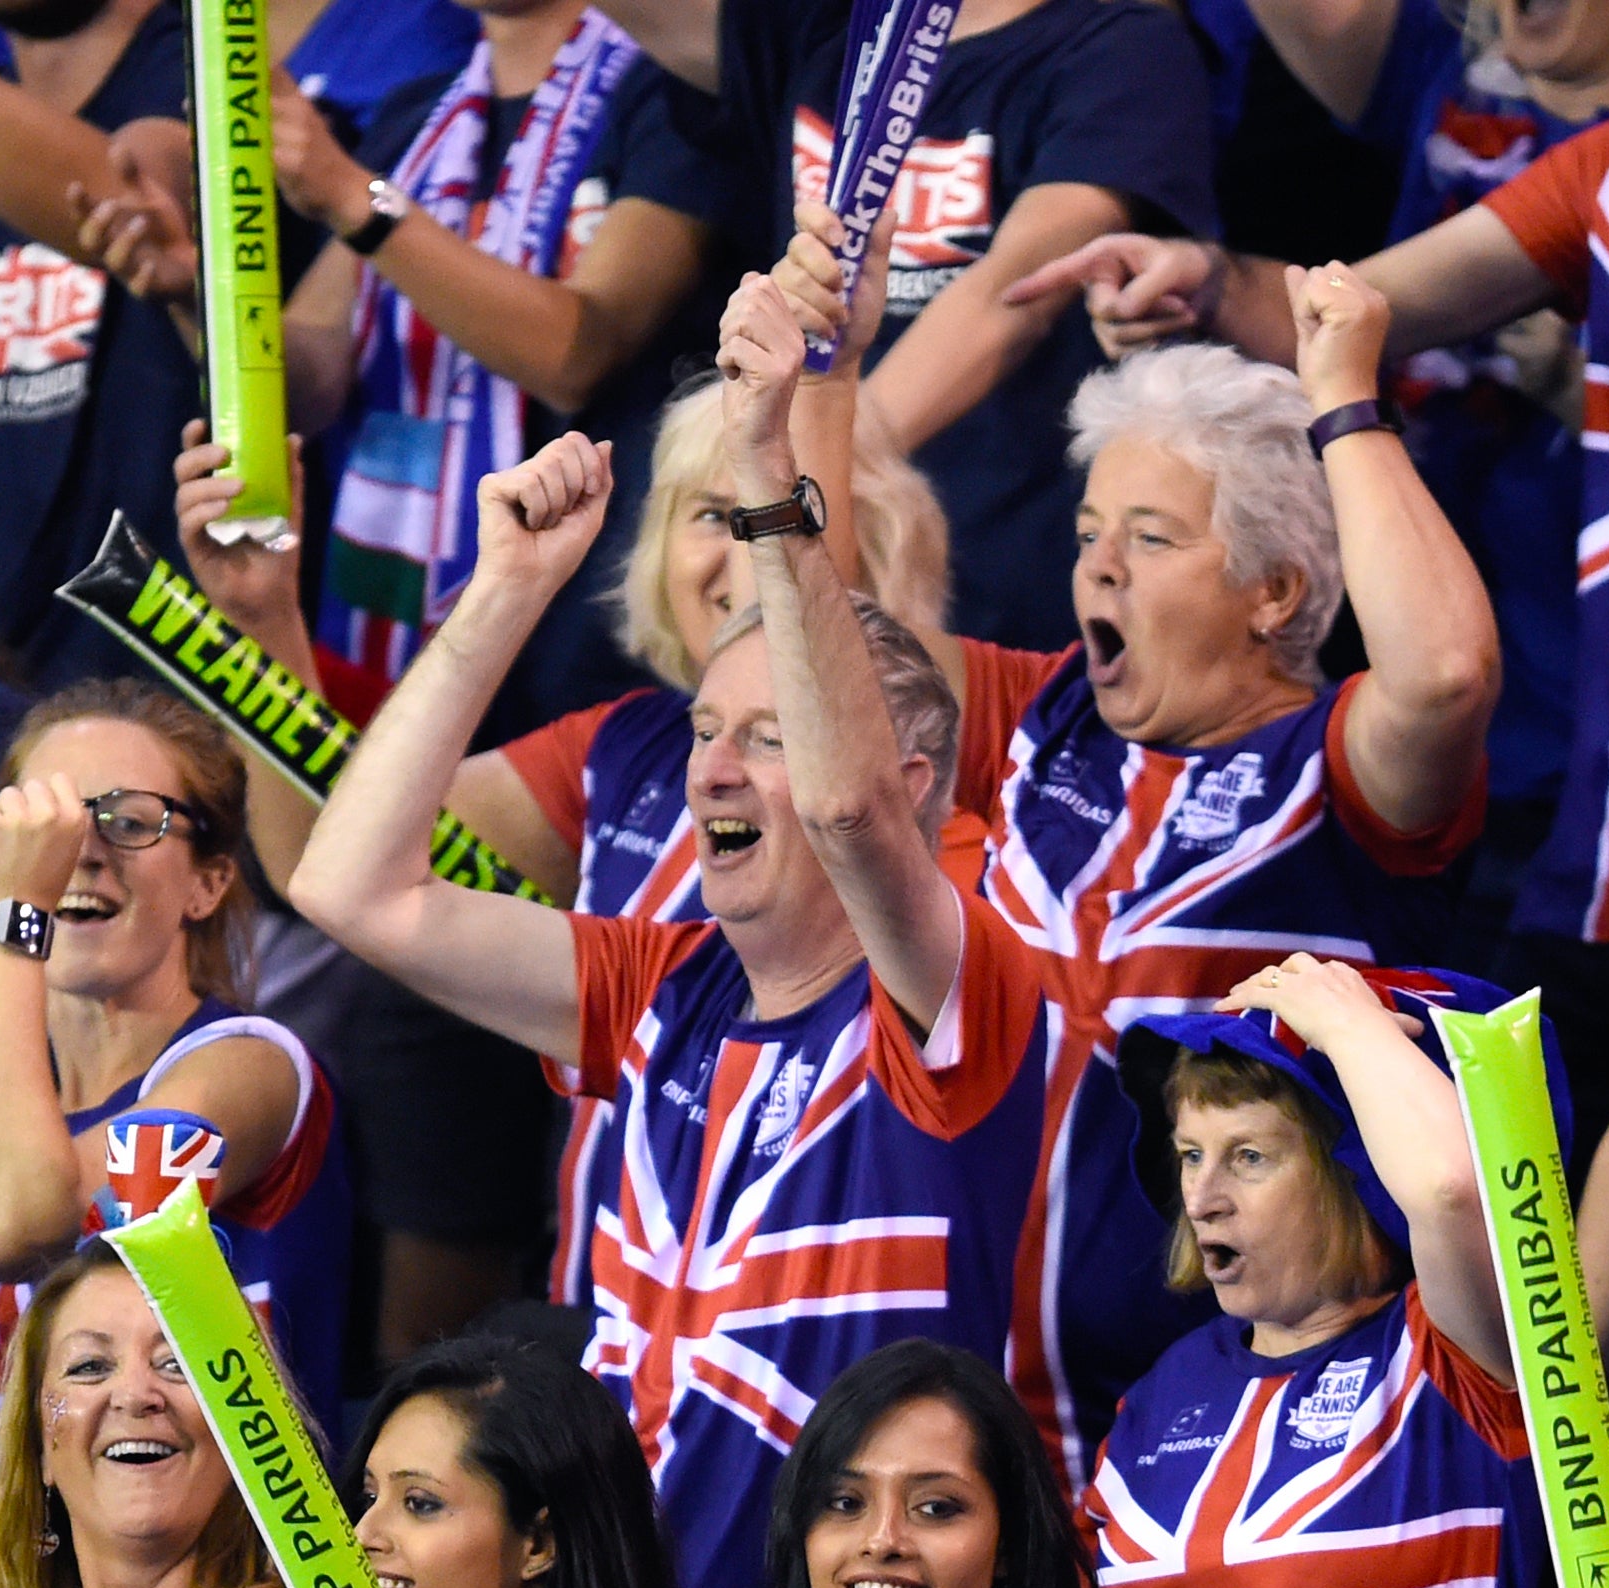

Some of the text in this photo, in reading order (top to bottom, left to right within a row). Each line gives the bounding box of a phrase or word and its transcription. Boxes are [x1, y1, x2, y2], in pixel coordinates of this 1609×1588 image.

[232, 165, 266, 272] BNP
[890, 158, 982, 226] ITS
[1548, 1151, 1577, 1227] world
[1567, 1227, 1598, 1342] changing
[1500, 1156, 1607, 1531] BNP PARIBAS
[1590, 1347, 1600, 1361] a
[1332, 1373, 1362, 1394] ARE
[206, 1347, 334, 1562] PARIBAS
[1157, 1434, 1224, 1454] PARIBAS
